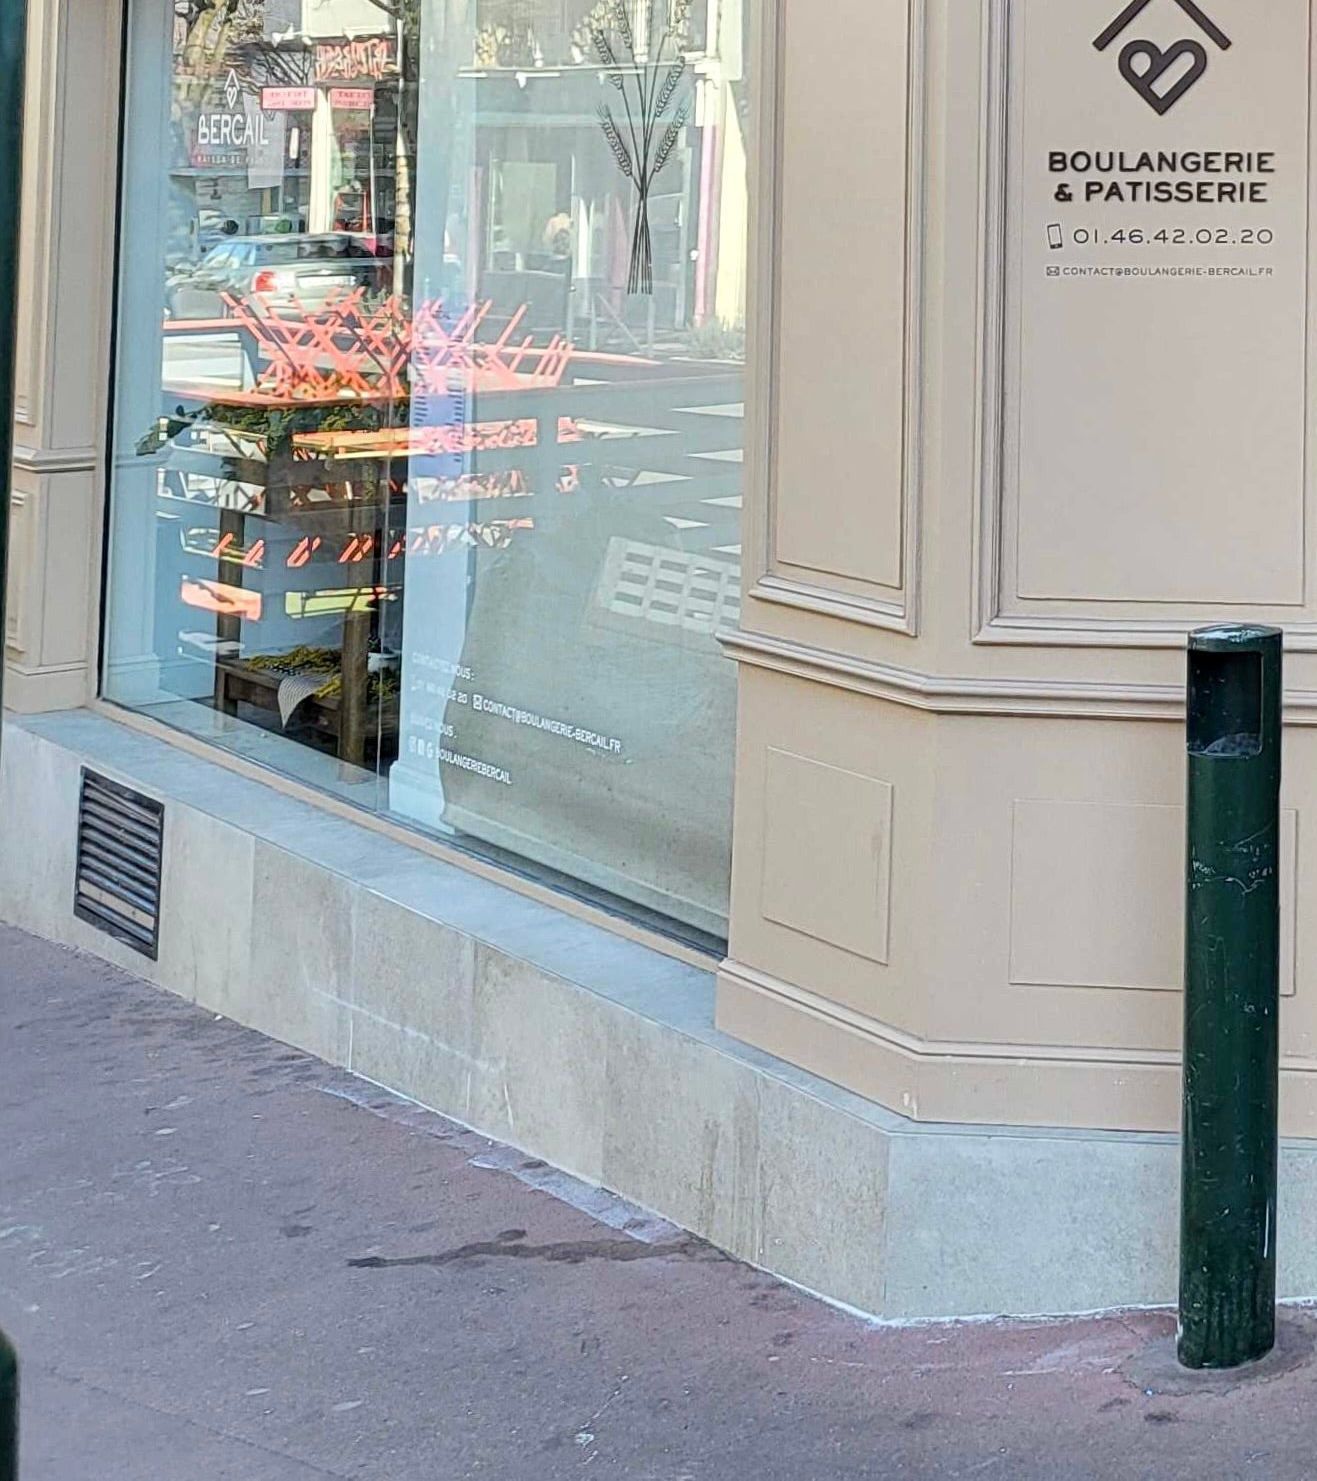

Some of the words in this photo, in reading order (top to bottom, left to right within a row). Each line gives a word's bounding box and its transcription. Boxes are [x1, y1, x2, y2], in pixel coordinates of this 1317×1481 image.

[198, 113, 269, 146] BERCAIL
[1048, 151, 1275, 173] BOULANGERIE
[1054, 182, 1073, 202] &
[1085, 181, 1267, 203] PATISSERIE
[1073, 228, 1273, 245] 01.46.42.02.20
[1063, 266, 1273, 277] CONTACT@BOULANGERIE-BERCAIL.FR
